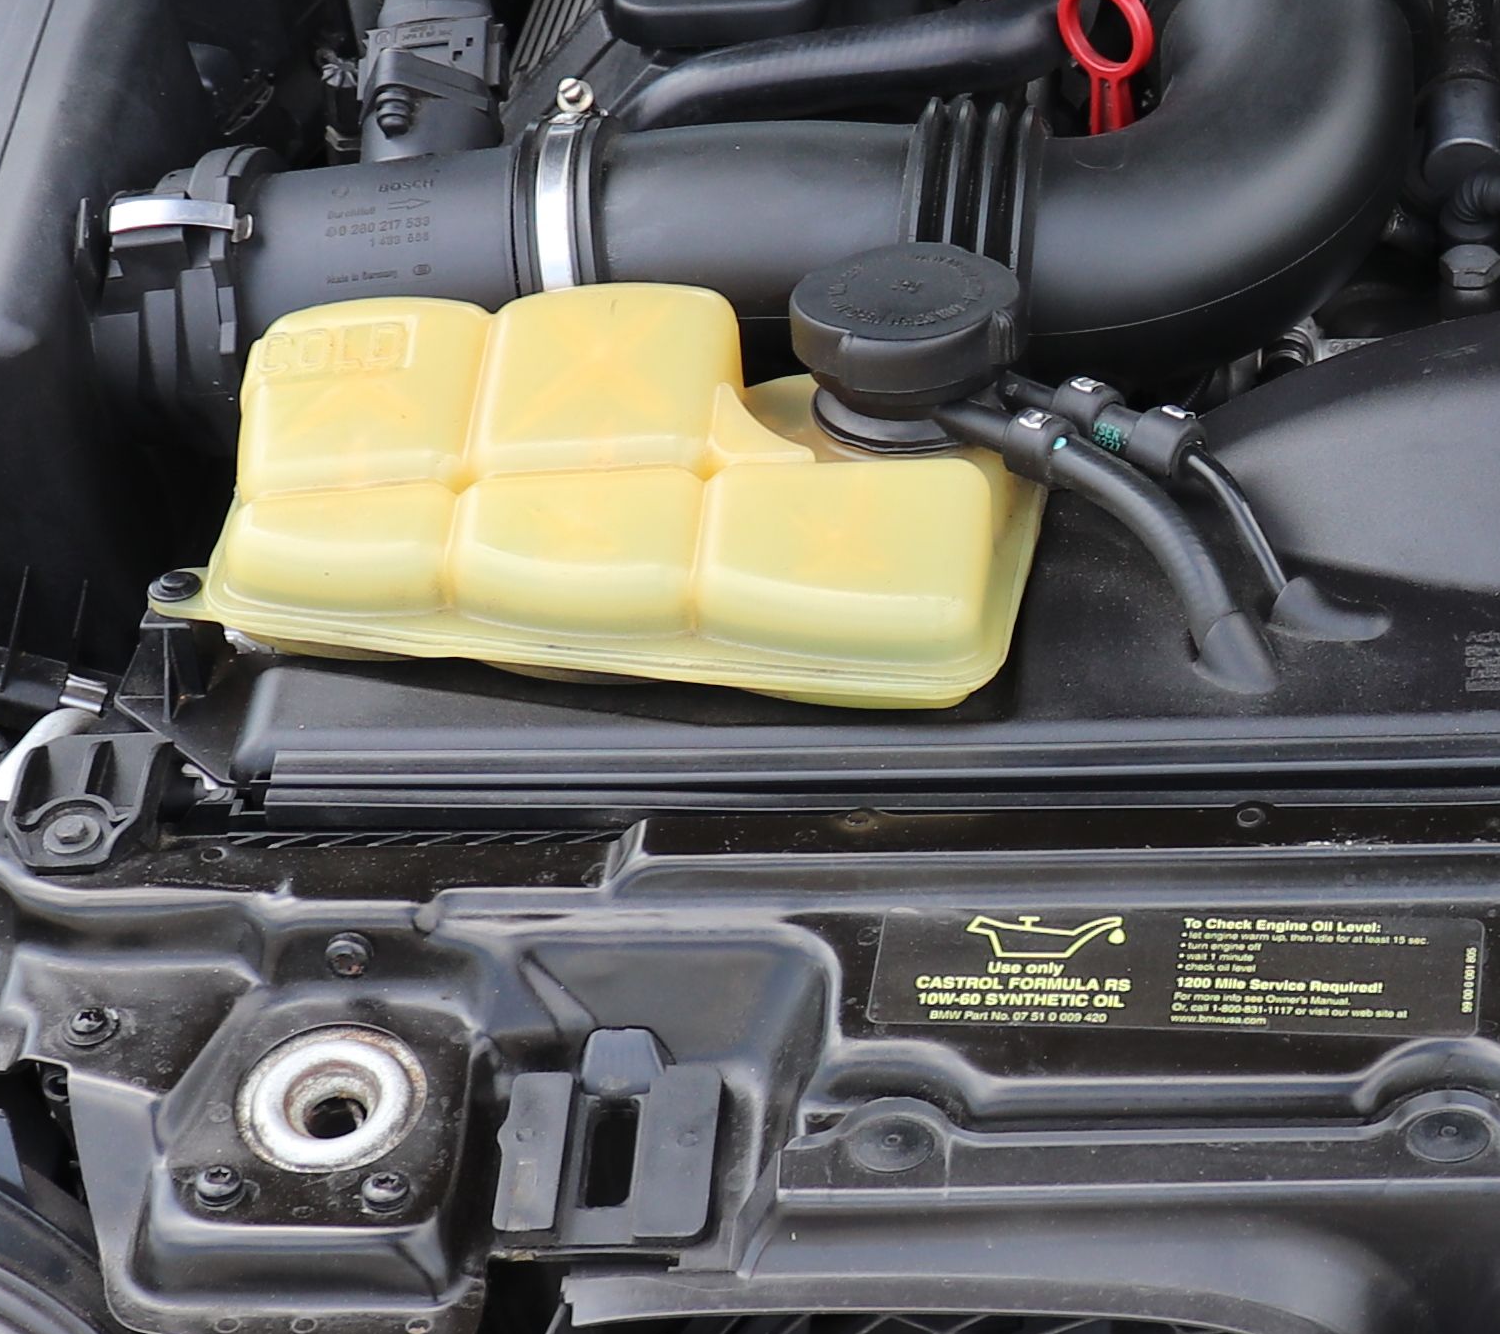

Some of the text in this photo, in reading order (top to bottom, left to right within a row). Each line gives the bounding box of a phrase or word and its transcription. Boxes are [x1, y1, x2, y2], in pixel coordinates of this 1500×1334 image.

[378, 177, 435, 194] BOSCH
[256, 321, 407, 374] COLD
[1183, 918, 1382, 934] To Check Engine Oil Level:
[1189, 931, 1203, 940] let
[1204, 932, 1239, 942] engine
[1240, 933, 1270, 941] warm
[1290, 934, 1314, 942] then
[1315, 934, 1334, 943] idle
[1336, 934, 1351, 943] for
[1364, 934, 1390, 944] least
[1187, 942, 1262, 952] turn engine off
[1218, 953, 1255, 962] minute
[987, 961, 1065, 977] Use only
[1184, 963, 1257, 973] check oil level
[915, 976, 1131, 992] CASTROL FORMULA RS
[1176, 976, 1384, 995] 1200 Mile Service Required!
[918, 992, 1125, 1008] 10W-60 SYNTHETIC OIL
[1173, 991, 1351, 1006] For more info see Owner's Manual.
[929, 1009, 962, 1021] BMW
[963, 1010, 989, 1021] Part
[990, 1010, 1011, 1021] No.
[1012, 1011, 1030, 1022] 07
[1030, 1011, 1045, 1022] 51
[1047, 1011, 1058, 1022] 0
[1083, 1012, 1108, 1023] 420
[1190, 1003, 1210, 1012] call
[1294, 1007, 1307, 1016] or
[1308, 1007, 1330, 1016] visit
[1330, 1009, 1350, 1017] our
[1351, 1008, 1374, 1018] web
[1374, 1009, 1395, 1018] site
[1170, 1014, 1267, 1025] www.bmwusa.com
